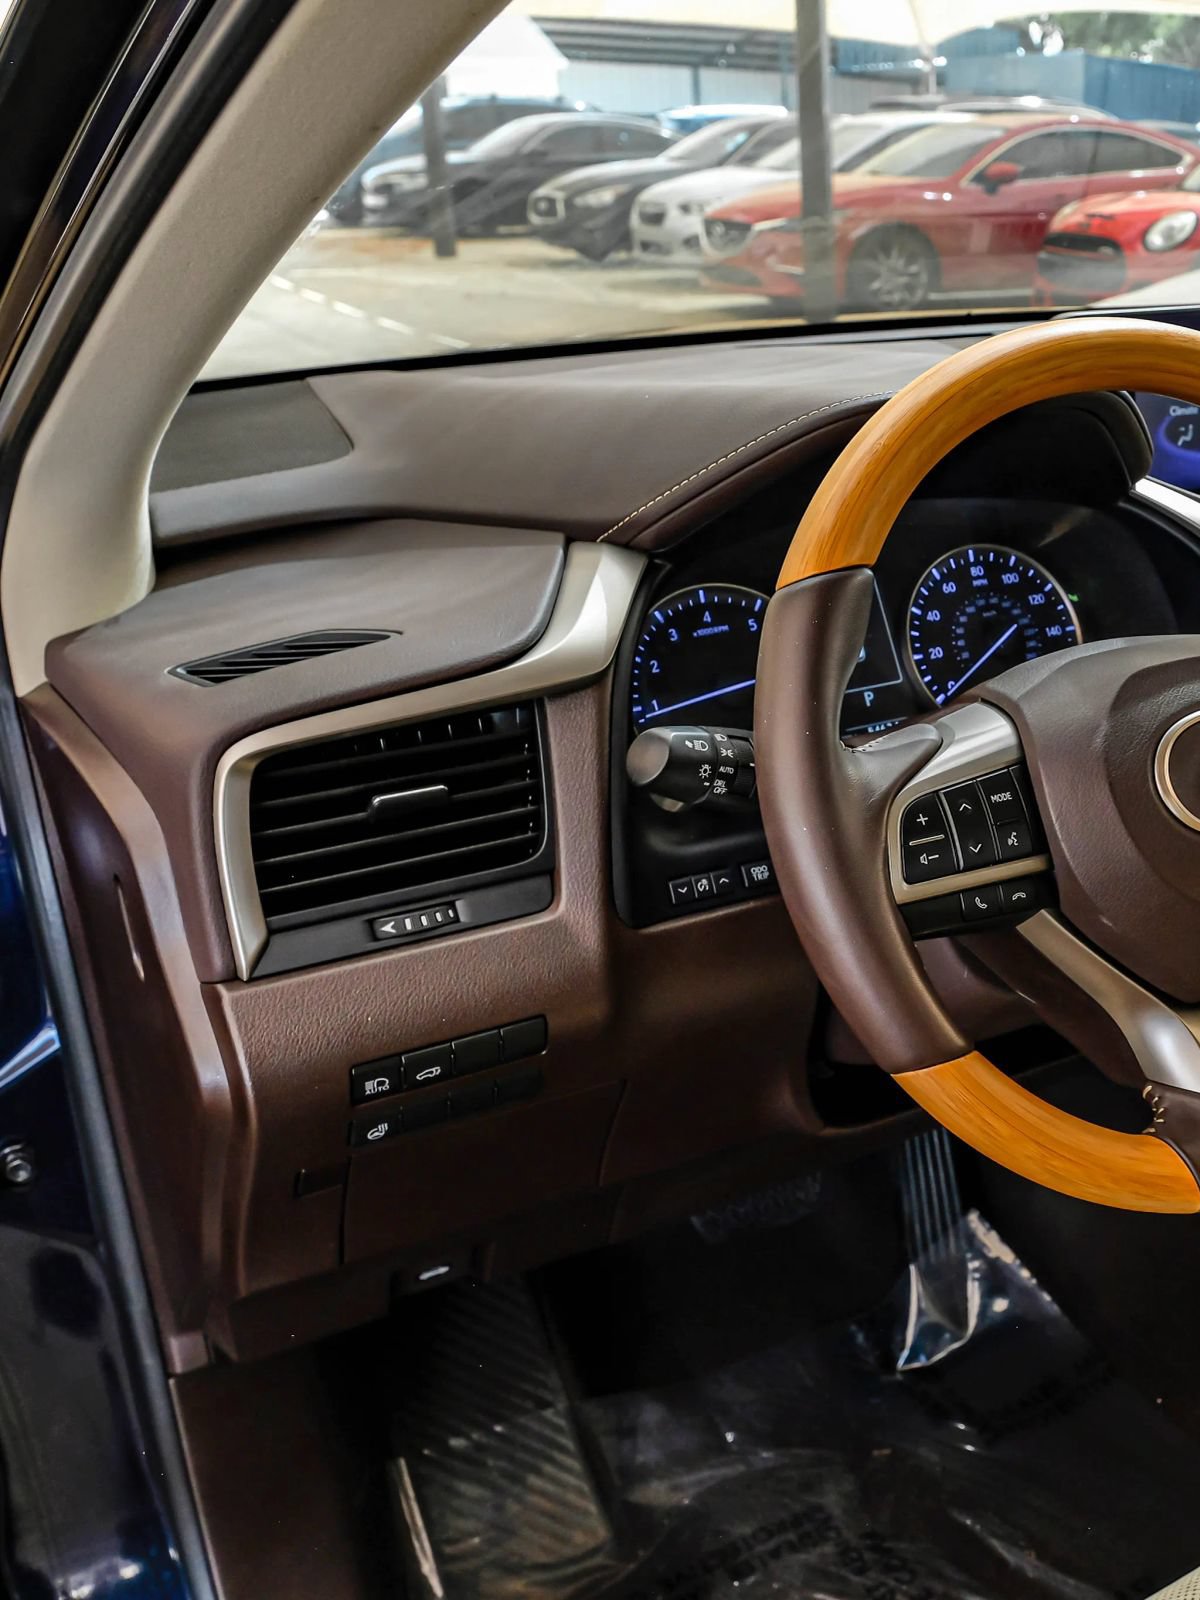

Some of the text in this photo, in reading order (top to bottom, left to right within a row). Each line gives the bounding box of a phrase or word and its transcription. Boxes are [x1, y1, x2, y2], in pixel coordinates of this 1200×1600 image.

[970, 565, 984, 577] 80
[1001, 572, 1019, 584] 100
[942, 581, 956, 594] 60
[1028, 593, 1046, 606] 120
[703, 610, 711, 622] 4
[926, 610, 941, 622] 40
[748, 618, 757, 631] 5
[668, 628, 678, 641] 3
[1045, 625, 1063, 637] 140
[928, 646, 943, 660] 20
[649, 660, 660, 673] 2
[651, 699, 659, 711] 1
[863, 691, 874, 707] P
[719, 765, 735, 775] AUTO
[713, 779, 726, 788] DRL
[713, 787, 728, 795] OFF
[990, 791, 1013, 803] MODE
[750, 865, 768, 874] ODO
[752, 871, 770, 882] TRIP
[364, 1083, 390, 1095] AUTO
